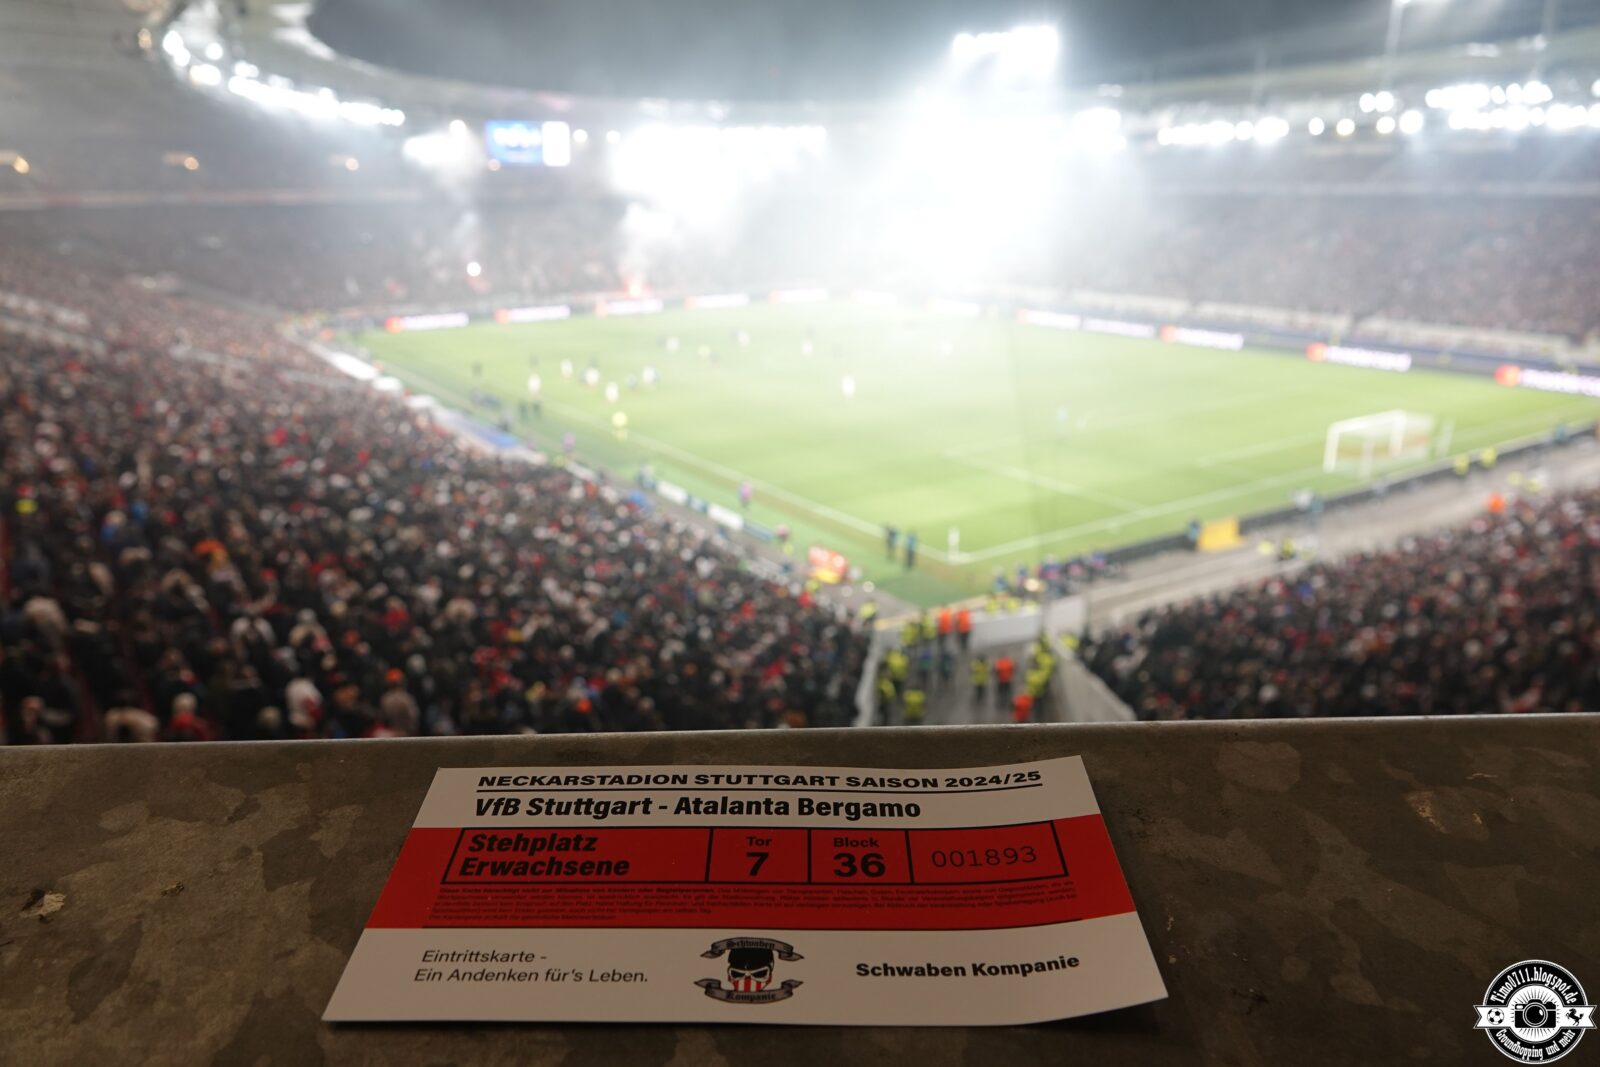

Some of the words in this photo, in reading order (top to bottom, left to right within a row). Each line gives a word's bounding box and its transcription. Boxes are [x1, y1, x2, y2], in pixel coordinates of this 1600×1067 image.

[478, 774, 688, 786] NECKARSTADION
[694, 774, 840, 786] STUTTGART
[845, 776, 939, 788] SAISON
[945, 771, 1042, 788] 2024/25
[476, 797, 521, 816] VfB
[526, 797, 652, 820] Stuttgart
[674, 796, 790, 815] Atalanta
[798, 797, 921, 821] Bergamo
[468, 833, 598, 856] Stehplatz
[746, 836, 772, 847] Tor
[833, 837, 880, 848] Block
[459, 857, 630, 877] Erwachsene
[745, 852, 771, 877] 7
[833, 853, 886, 877] 36
[931, 846, 1038, 868] 001893
[421, 950, 535, 963] Eintrittskarte
[856, 963, 966, 977] Schwaben
[972, 956, 1080, 977] Kompanie
[414, 969, 442, 982] Ein
[448, 968, 539, 982] Andenken
[545, 968, 583, 982] für's
[589, 969, 648, 982] Leben.
